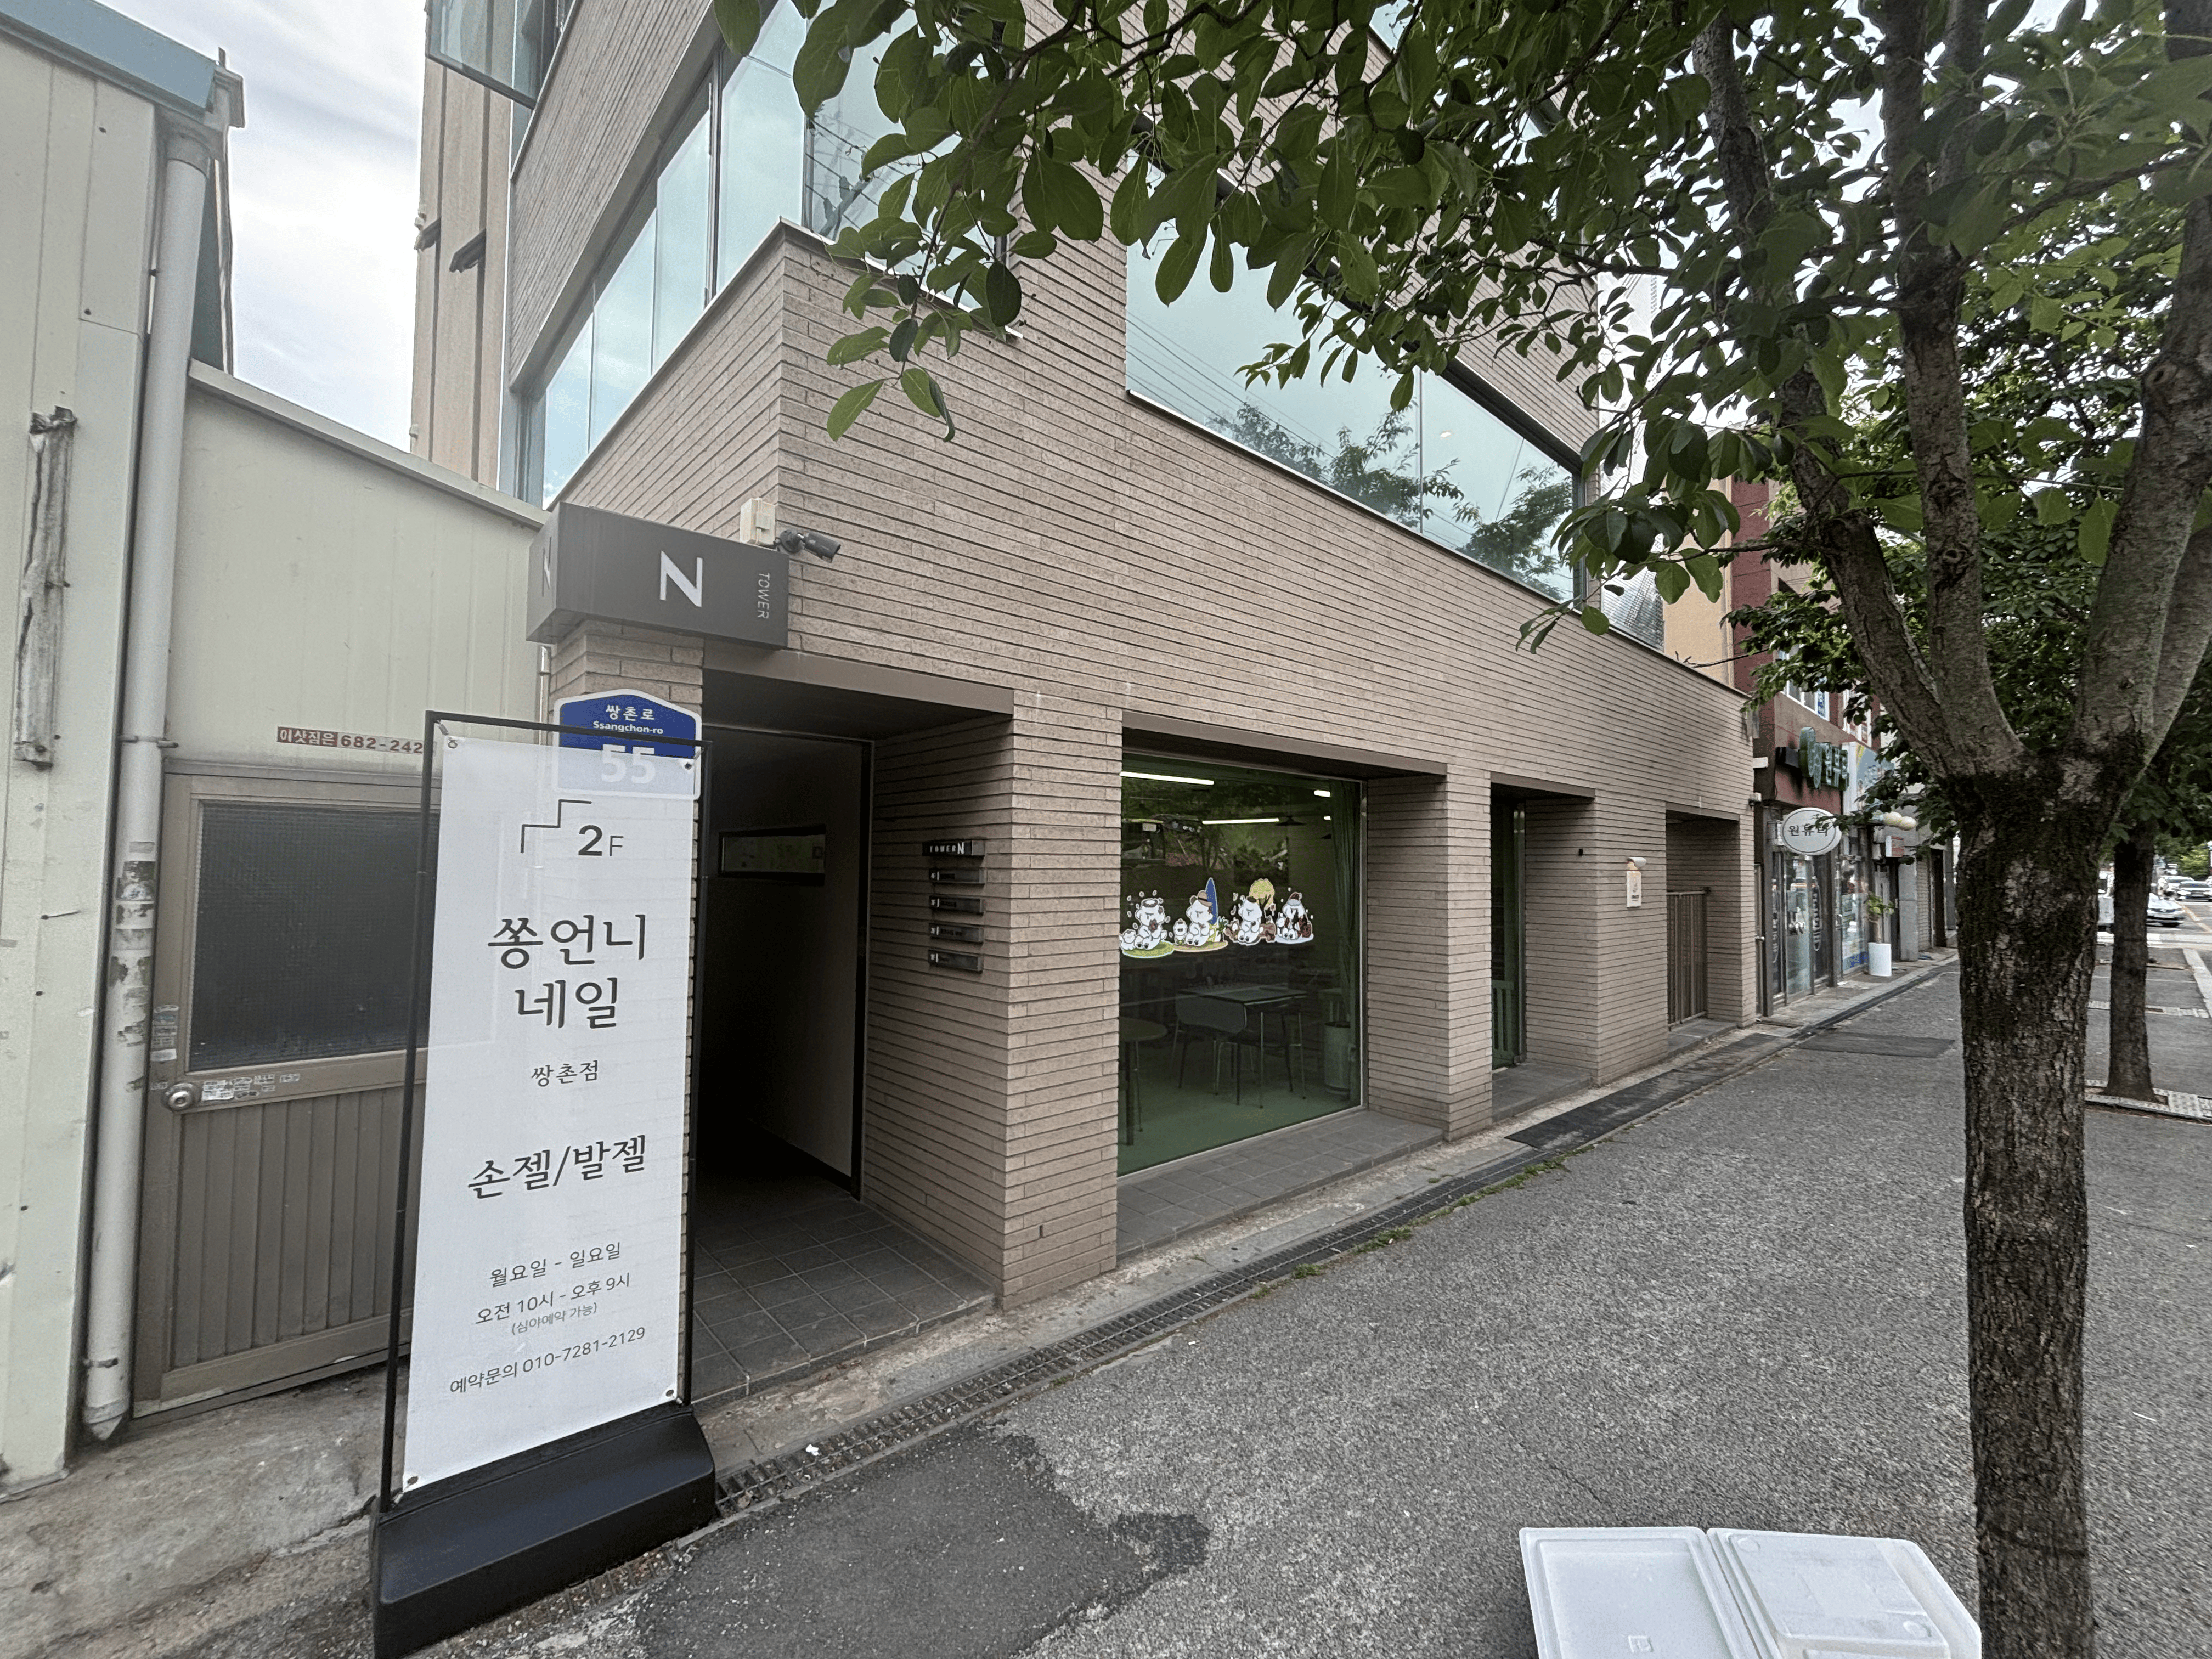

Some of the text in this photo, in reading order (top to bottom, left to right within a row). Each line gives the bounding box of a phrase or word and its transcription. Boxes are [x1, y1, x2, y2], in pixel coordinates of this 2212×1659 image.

[659, 550, 703, 608] N
[757, 572, 770, 620] TOWER
[592, 720, 664, 735] Ssangchon-ro
[605, 704, 655, 721] 쌍촌로
[279, 728, 423, 754] 이삿짐은 682-242
[601, 743, 656, 784] 55
[578, 825, 624, 857] 2F
[514, 977, 618, 1029] 네일
[531, 1059, 599, 1087] 쌍촌점
[467, 1135, 646, 1199] 손젤/발젤
[489, 1259, 547, 1288] 월요일
[569, 1242, 622, 1269] 일요일
[475, 1302, 511, 1325] 오전
[517, 1291, 554, 1314] 10시
[570, 1280, 602, 1301] 오후
[606, 1272, 630, 1291] 9시
[511, 1302, 598, 1335] (심야예약 가능)
[450, 1327, 645, 1393] 예약문의 010-7281-2129
